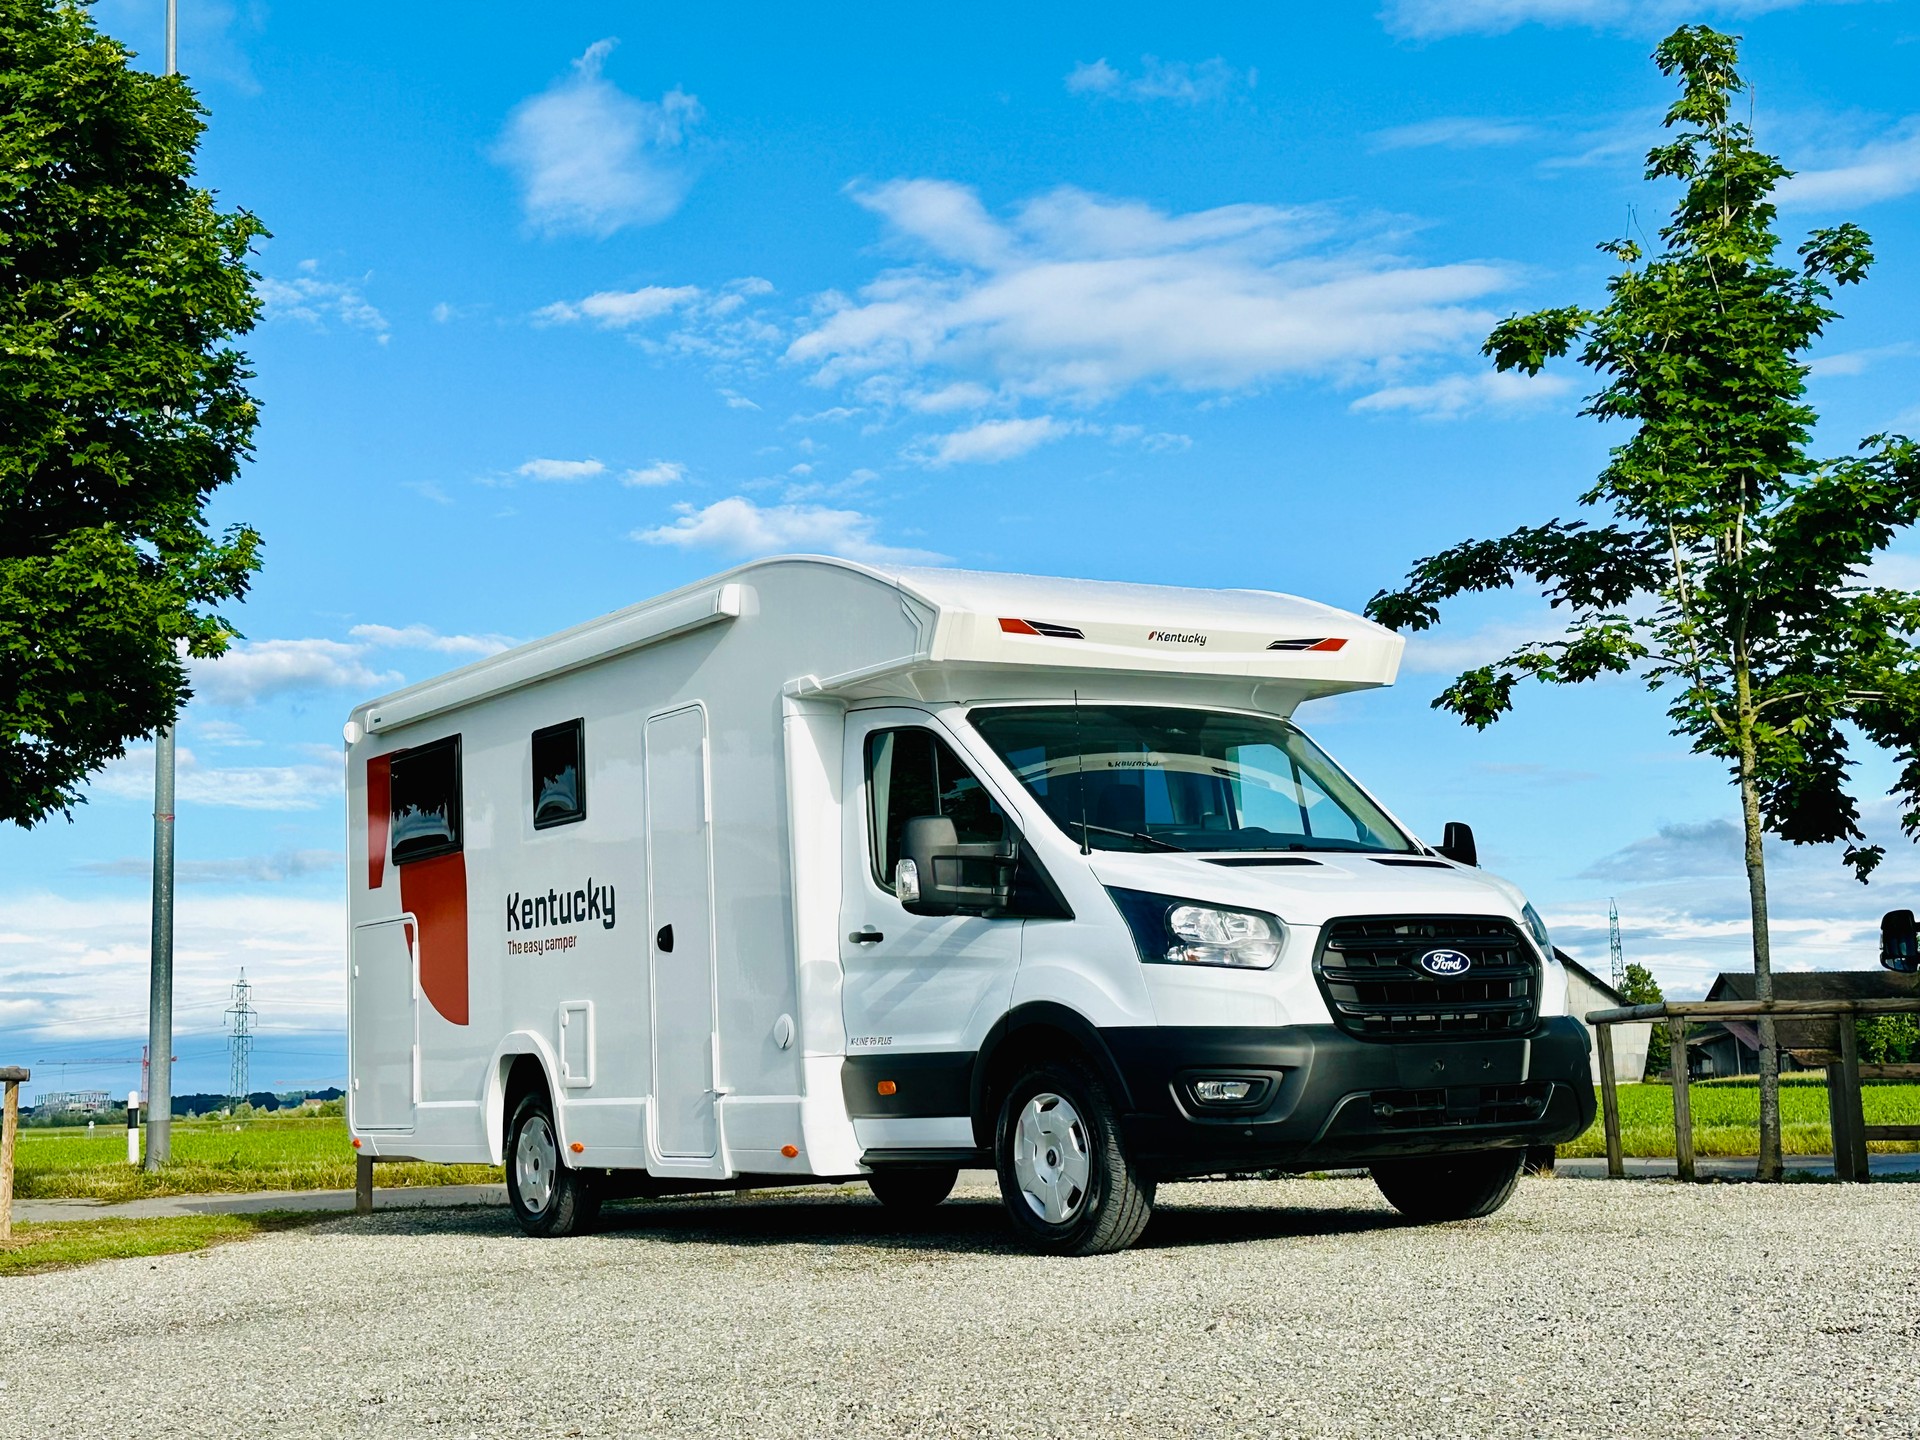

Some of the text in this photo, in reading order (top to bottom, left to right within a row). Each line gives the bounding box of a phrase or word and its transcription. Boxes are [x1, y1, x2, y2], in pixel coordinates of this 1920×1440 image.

[1156, 631, 1207, 647] Kentucky
[507, 877, 616, 932] Kentucky
[507, 935, 578, 956] The easy camper
[1431, 953, 1462, 970] Ford
[878, 1036, 893, 1046] PLUS
